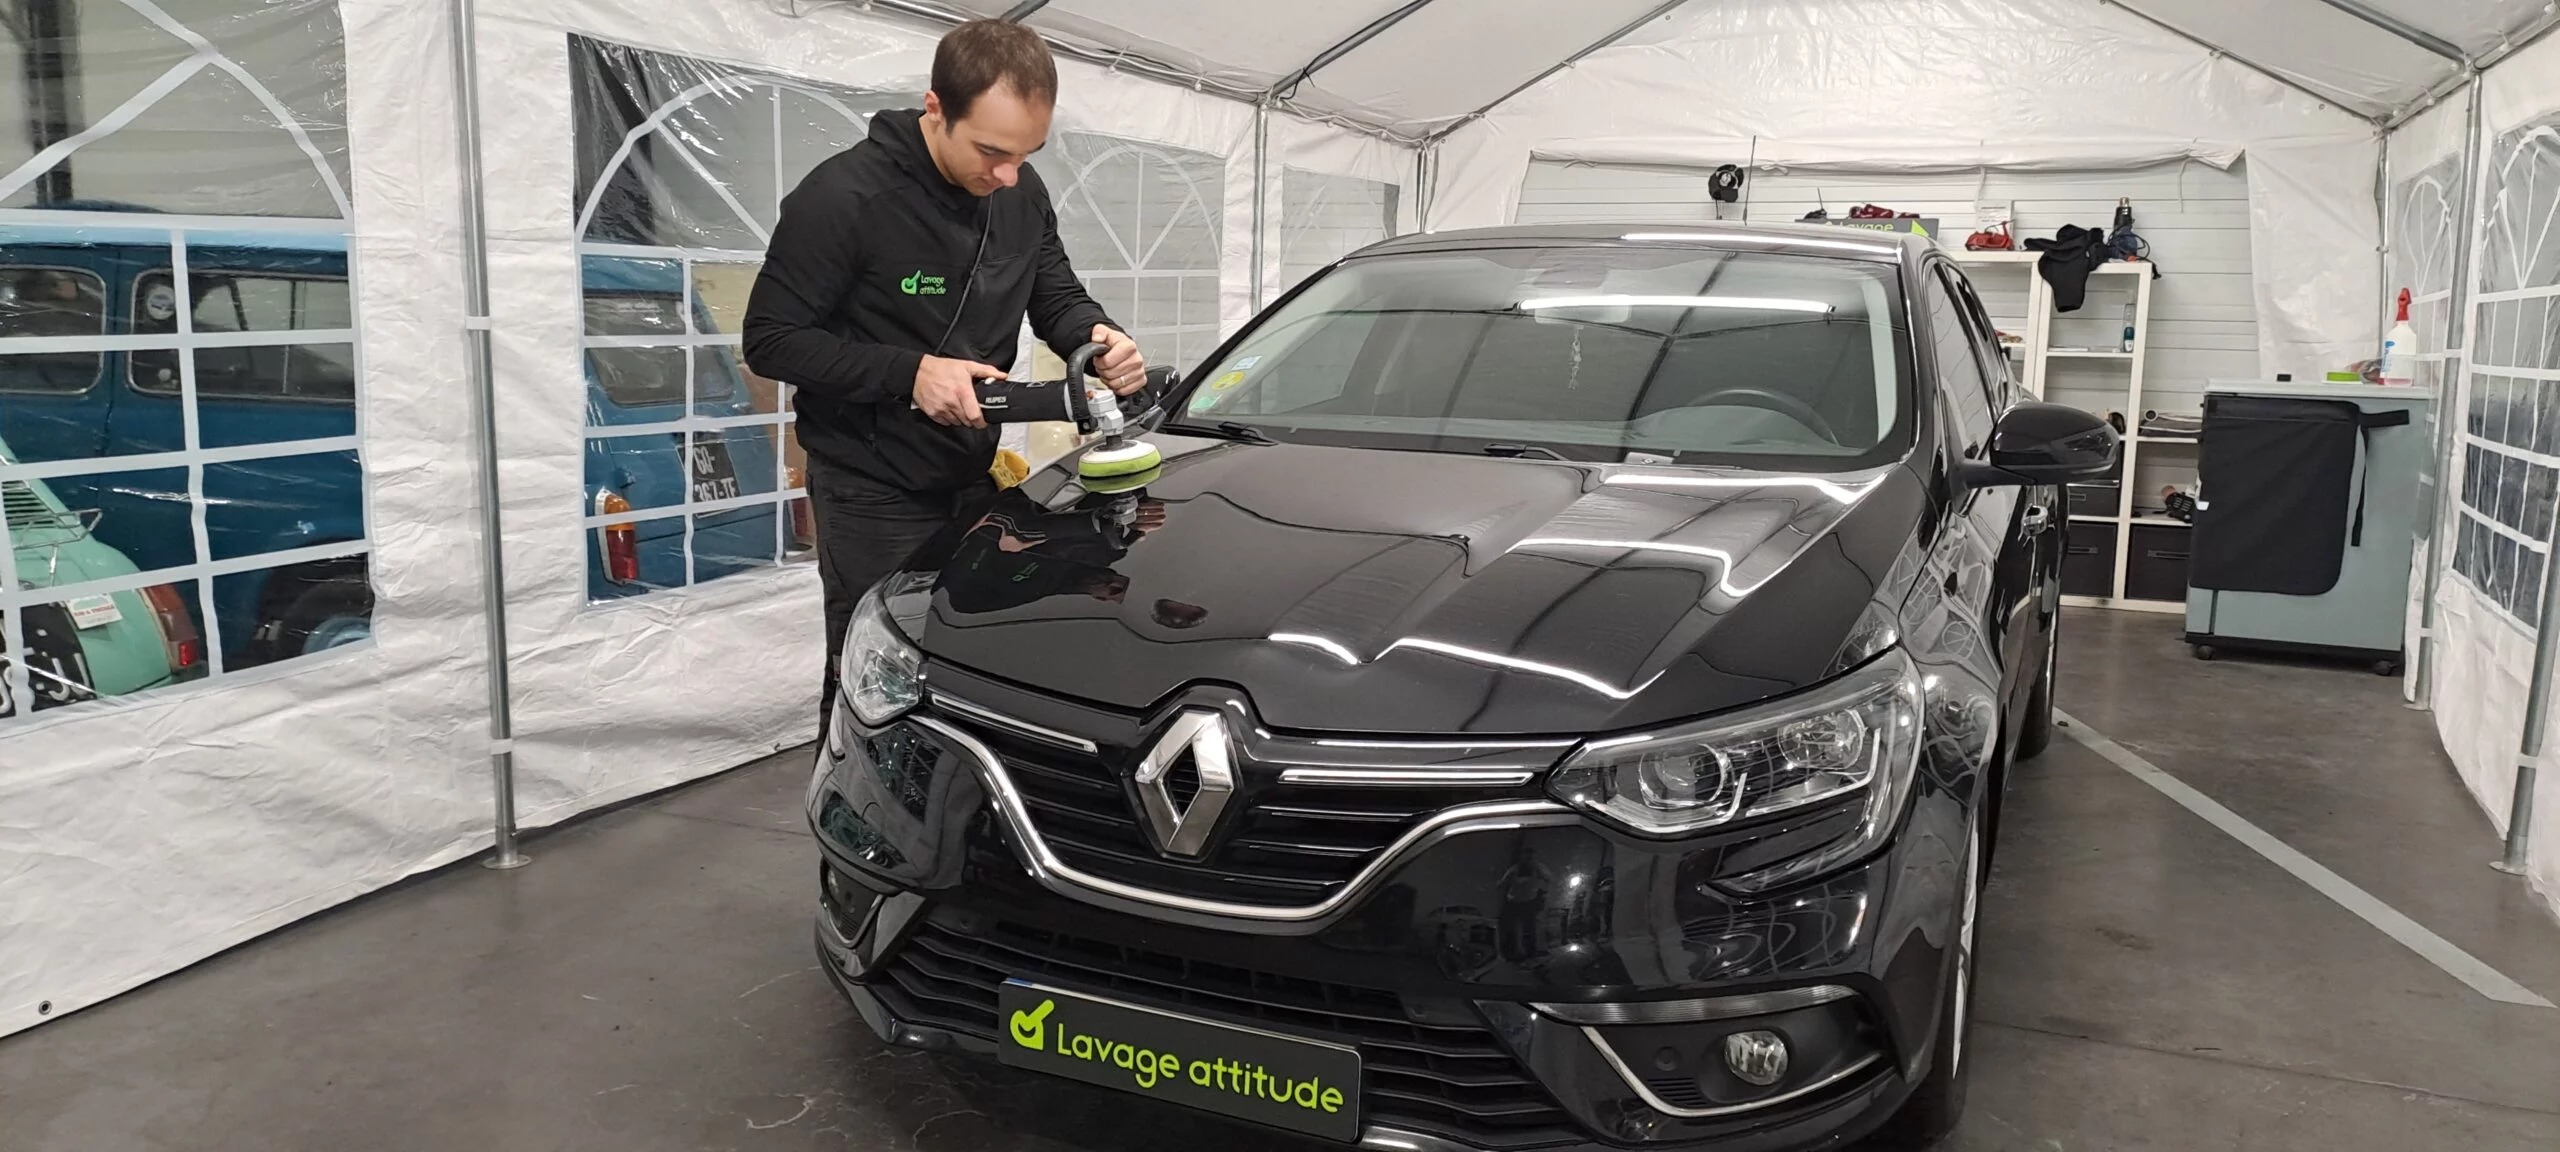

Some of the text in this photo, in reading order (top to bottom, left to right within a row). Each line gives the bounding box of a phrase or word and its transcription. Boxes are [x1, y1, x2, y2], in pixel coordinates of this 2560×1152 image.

[920, 275, 945, 287] Lavage
[985, 396, 1007, 404] RUPES
[1057, 1022, 1345, 1113] Lavage attitude
